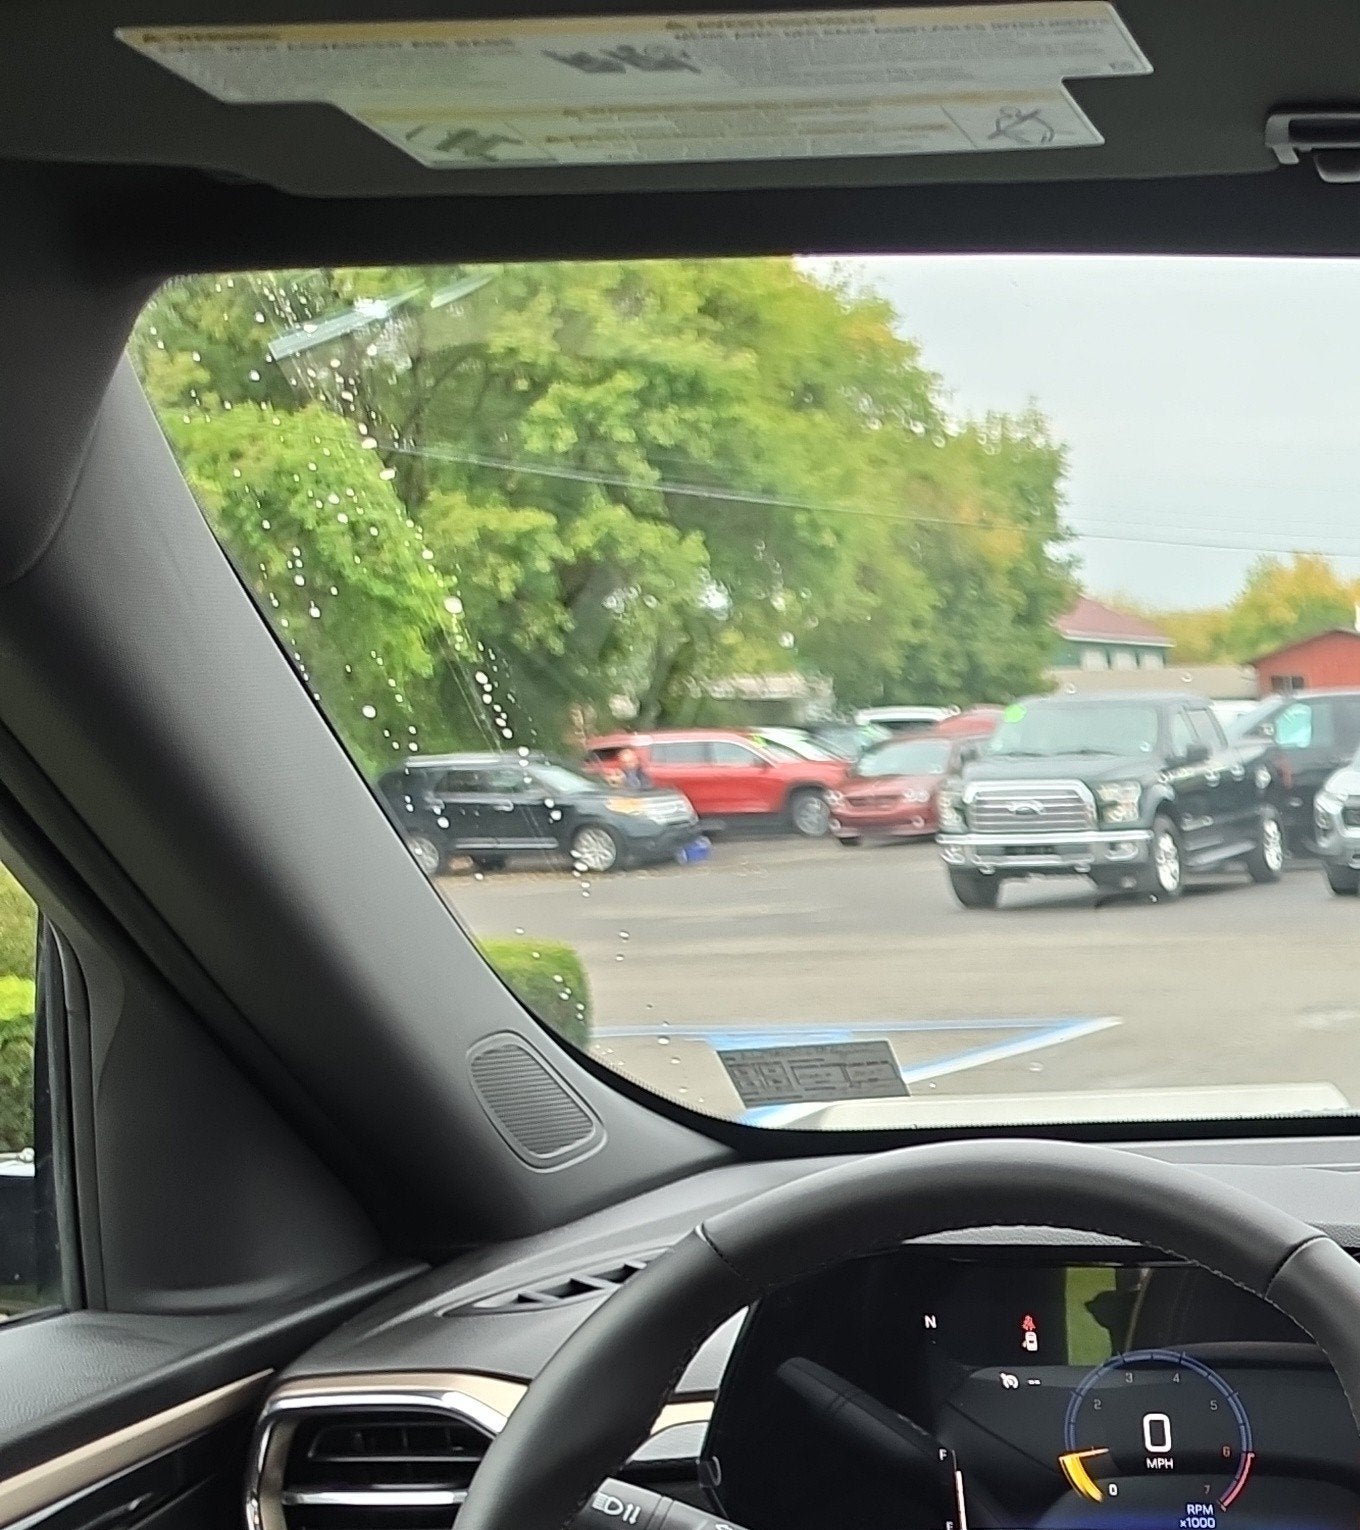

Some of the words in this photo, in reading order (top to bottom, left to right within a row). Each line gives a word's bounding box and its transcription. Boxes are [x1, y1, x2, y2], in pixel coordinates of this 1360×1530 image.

[924, 1315, 937, 1329] N
[1125, 1372, 1134, 1384] 3
[1171, 1372, 1181, 1384] 4
[1209, 1400, 1219, 1411] 5
[1142, 1413, 1172, 1453] 0
[938, 1449, 948, 1461] F
[1146, 1457, 1174, 1470] MPH
[1186, 1504, 1214, 1516] RPM
